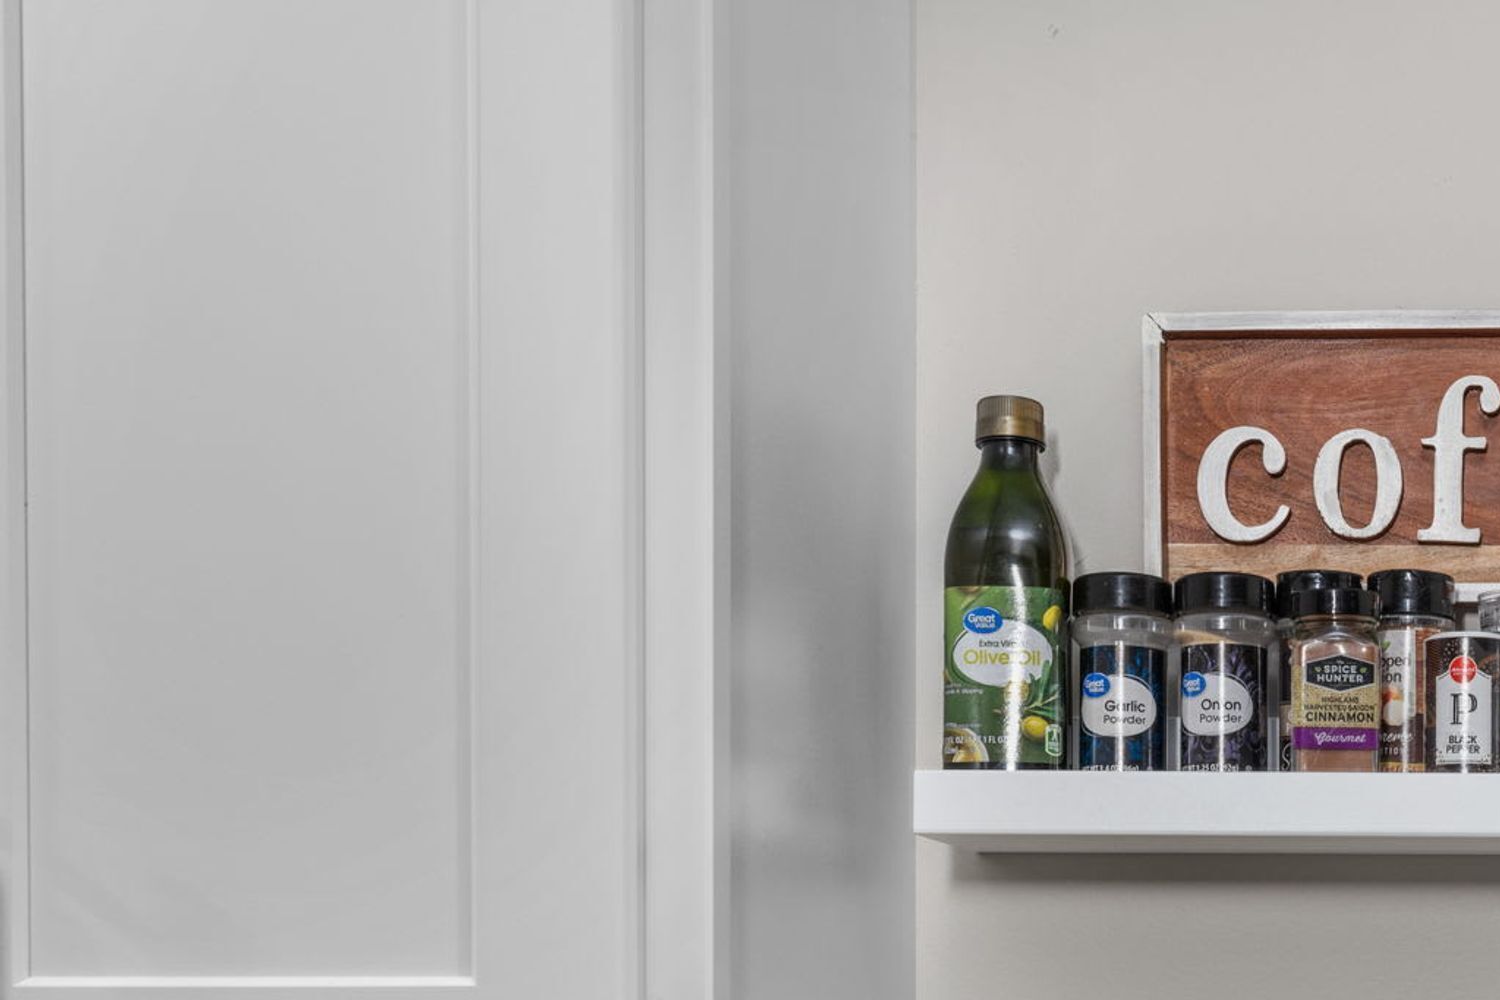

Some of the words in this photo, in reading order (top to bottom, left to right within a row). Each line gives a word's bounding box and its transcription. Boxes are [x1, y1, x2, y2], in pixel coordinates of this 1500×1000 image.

[968, 613, 996, 623] Great
[963, 648, 1009, 665] Olive
[1324, 665, 1357, 674] SPICE
[1317, 674, 1364, 683] HUNTER
[1450, 693, 1478, 725] P
[1305, 711, 1375, 723] CINNAMON
[1314, 731, 1367, 746] Gourmet
